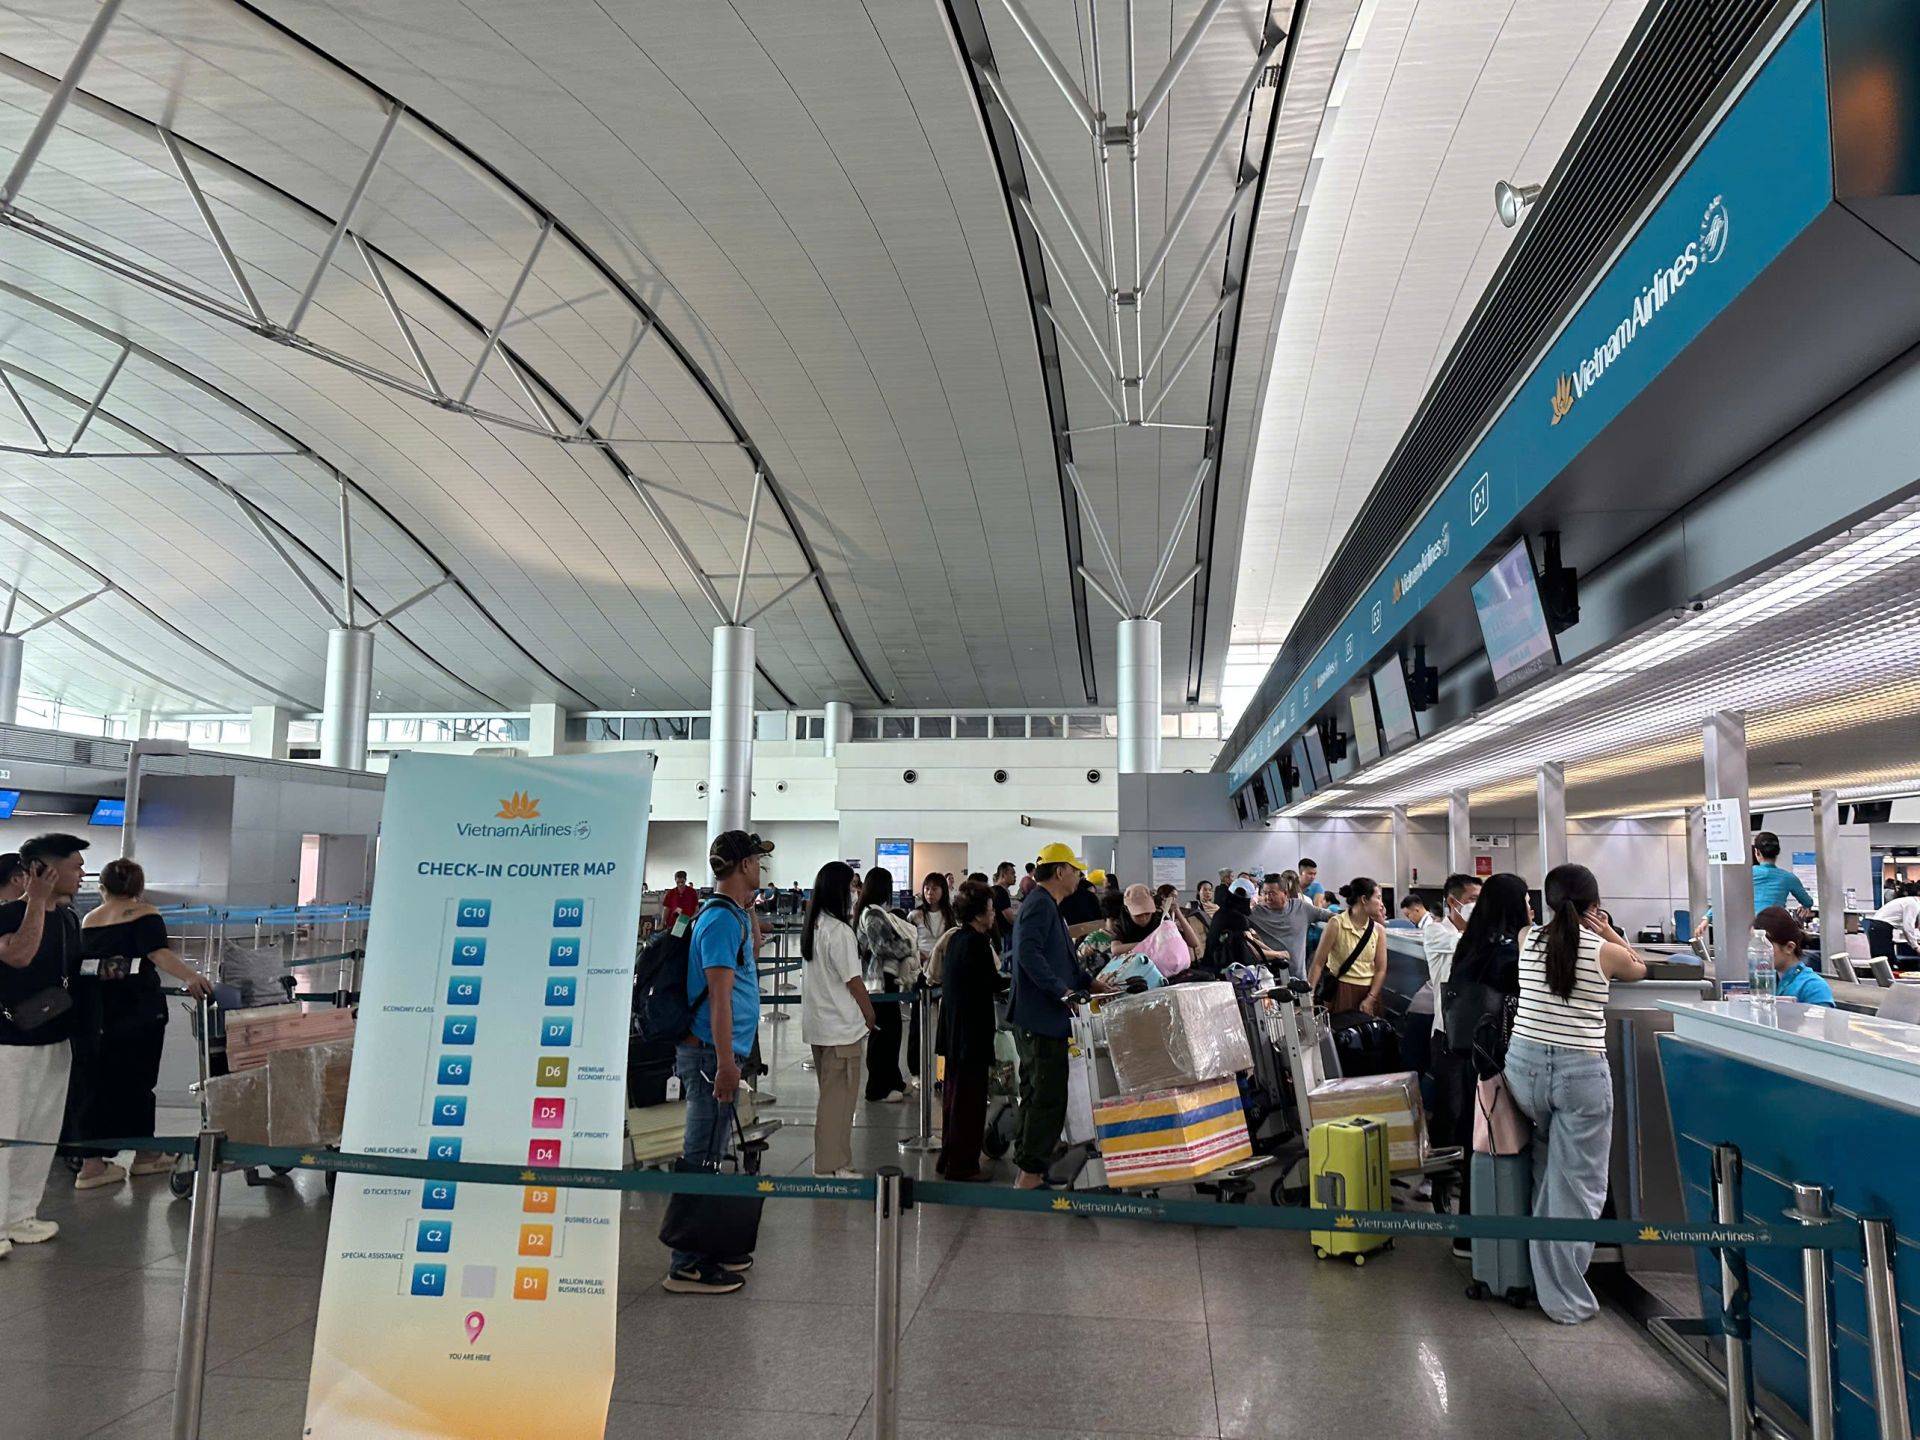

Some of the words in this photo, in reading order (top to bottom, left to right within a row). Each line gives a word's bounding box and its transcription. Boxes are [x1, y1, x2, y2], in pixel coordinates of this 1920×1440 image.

[1474, 485, 1485, 513] C-1
[418, 862, 502, 877] CHECK-IN
[507, 863, 579, 877] COUNTER
[584, 862, 616, 876] MAP
[463, 907, 486, 919] C10
[558, 907, 579, 919] D10
[462, 946, 478, 957] C9
[557, 946, 573, 957] D9
[457, 984, 473, 996] C8
[554, 985, 569, 997] D8
[383, 1005, 415, 1013] ECONOMY
[452, 1024, 467, 1035] C7
[550, 1026, 565, 1037] D7
[447, 1064, 463, 1076] C6
[545, 1066, 561, 1077] D6
[442, 1105, 457, 1116] C5
[541, 1107, 557, 1118] D5
[584, 1131, 609, 1139] PRIORITY
[437, 1146, 453, 1157] C4
[537, 1149, 553, 1160] D4
[432, 1188, 447, 1199] C3
[532, 1191, 548, 1203] D3
[565, 1216, 592, 1224] BUSINESS
[427, 1230, 441, 1242] C2
[528, 1234, 544, 1246] D2
[367, 1252, 404, 1260] ASSISTANCE
[421, 1273, 435, 1285] C1
[523, 1278, 538, 1289] D1
[558, 1286, 586, 1294] BUSINESS
[587, 1287, 605, 1295] CLASS
[475, 1353, 491, 1361] HERE
